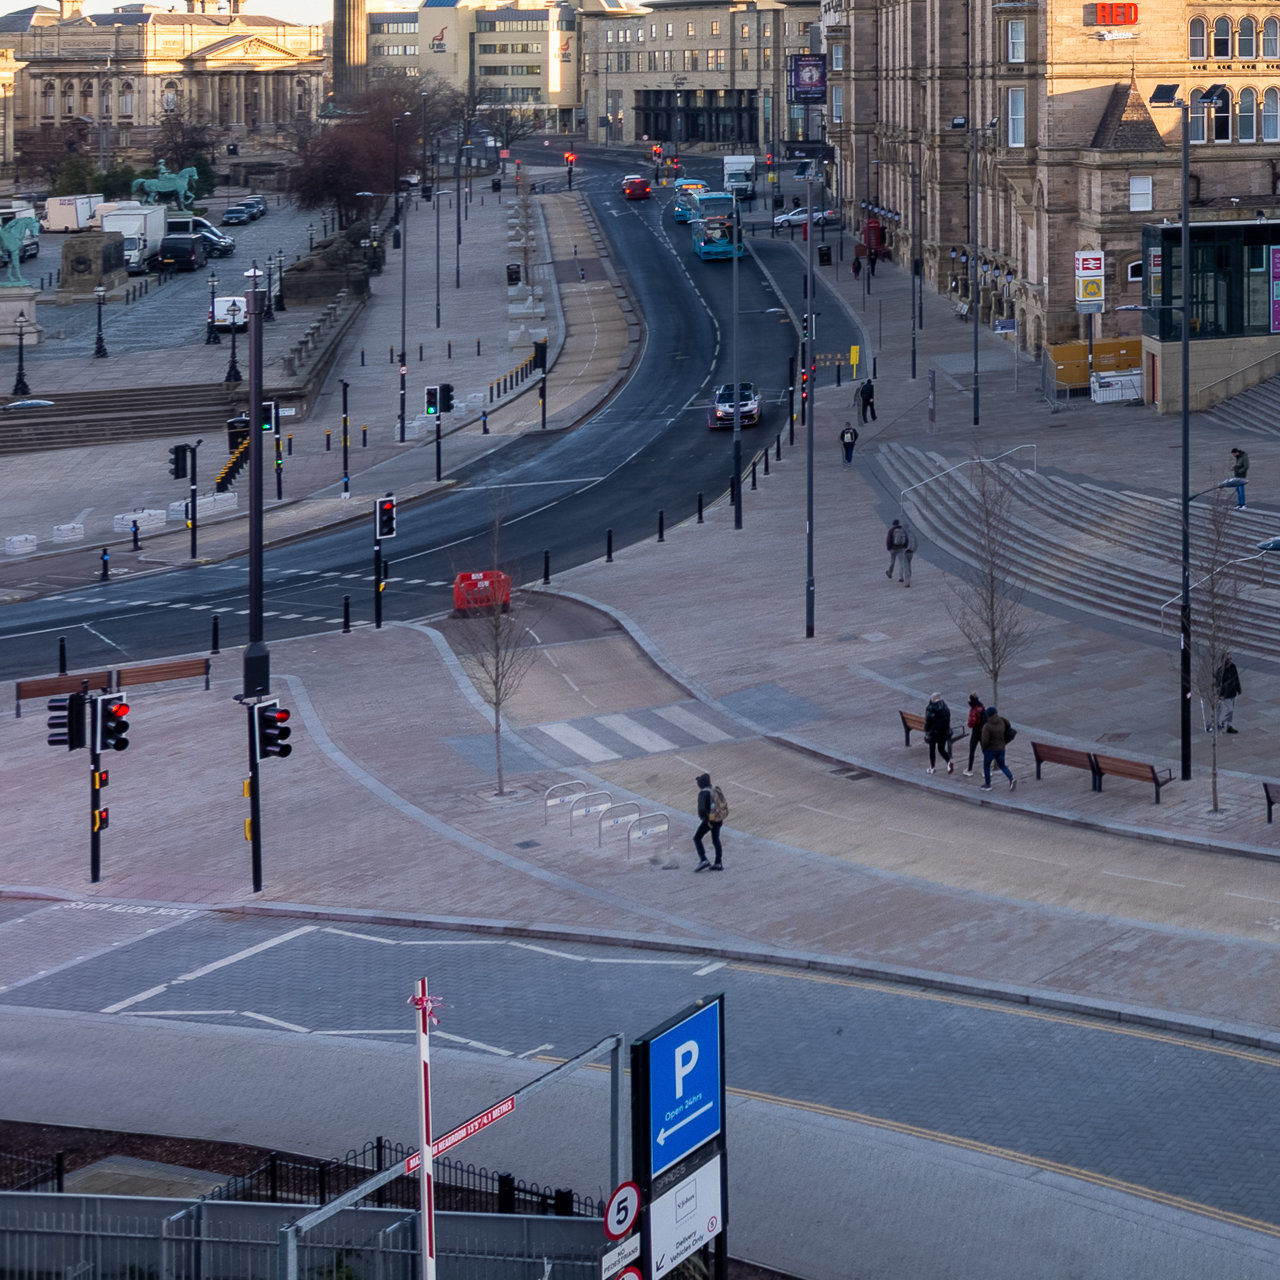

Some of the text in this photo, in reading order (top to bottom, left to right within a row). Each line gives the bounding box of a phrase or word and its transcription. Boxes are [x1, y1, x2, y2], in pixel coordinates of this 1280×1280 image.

[1097, 3, 1138, 25] RED
[429, 42, 446, 50] unite
[675, 1040, 699, 1100] P
[492, 1101, 512, 1119] METRES
[664, 1093, 703, 1122] Open 24hrs
[616, 1197, 629, 1225] 5
[670, 1234, 704, 1263] Vehicles Only
[675, 1230, 697, 1249] Delivery
[604, 1246, 639, 1273] PEDESTRIANS
[617, 1248, 626, 1257] NO
